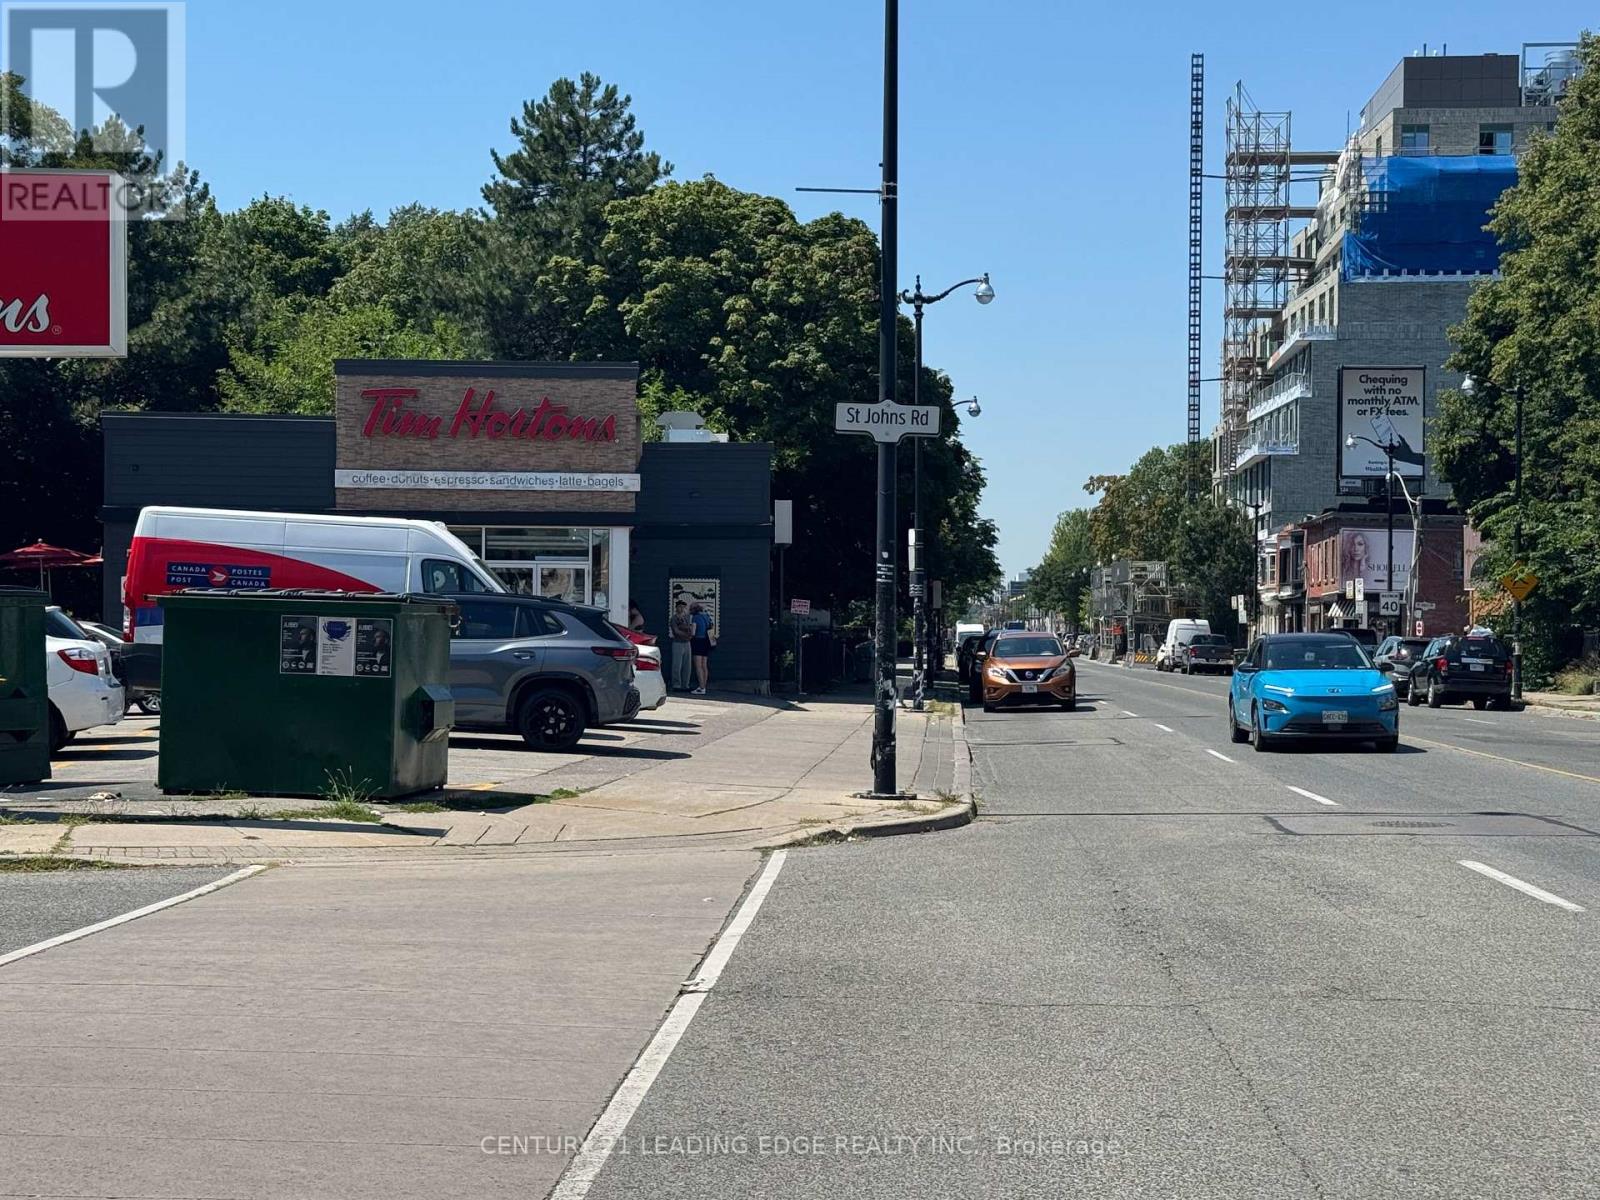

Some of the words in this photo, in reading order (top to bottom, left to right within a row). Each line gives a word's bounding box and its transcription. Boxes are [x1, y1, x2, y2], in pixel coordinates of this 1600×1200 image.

[1359, 374, 1408, 386] Chequing
[1364, 385, 1386, 395] with
[1388, 387, 1402, 395] no
[1347, 395, 1391, 407] monthly,
[360, 387, 443, 438] Tim
[450, 387, 616, 441] Hortons
[1356, 408, 1368, 416] or
[1370, 407, 1383, 416] FX
[1385, 406, 1409, 416] fees.
[846, 407, 860, 424] St
[864, 408, 906, 425] Johns
[911, 409, 929, 426] Rd
[171, 565, 206, 573] CANADA
[231, 568, 263, 576] POSTES
[170, 576, 192, 584] POST
[231, 579, 266, 588] CANADA
[1381, 601, 1398, 612] 40
